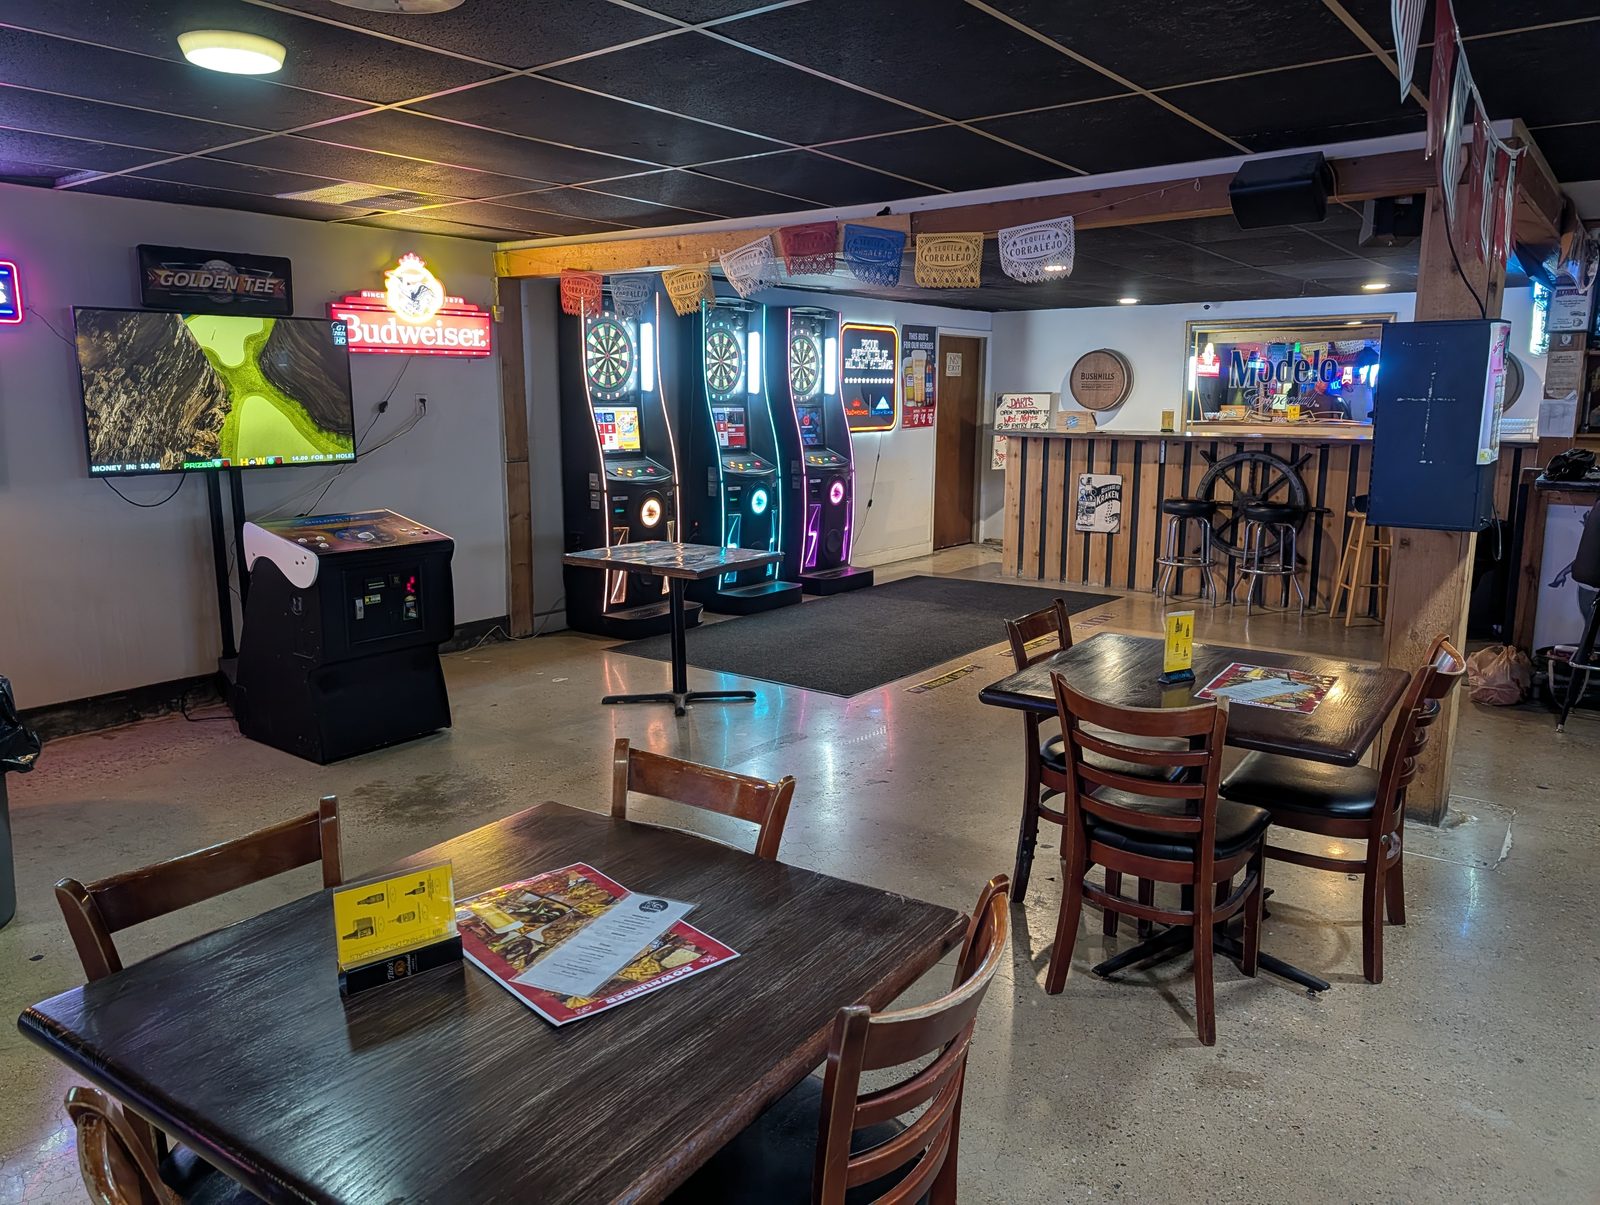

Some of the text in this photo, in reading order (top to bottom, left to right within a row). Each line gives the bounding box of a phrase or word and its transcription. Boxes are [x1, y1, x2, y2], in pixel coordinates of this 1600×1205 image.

[1020, 235, 1051, 246] TEQUILA
[934, 245, 962, 253] TEQUILA
[1010, 240, 1063, 257] CORRALEJO
[924, 253, 971, 262] CORRALEJO
[160, 271, 274, 293] GOLDEN TEE
[672, 279, 704, 293] CORRALEJO
[362, 291, 385, 299] SINCE
[909, 332, 918, 341] THIS
[911, 341, 919, 349] OUR
[919, 342, 934, 350] HEROES
[1228, 348, 1339, 390] Modelo
[1080, 372, 1115, 380] BUSHMILLS
[1010, 397, 1034, 408] DARTS
[140, 462, 160, 470] $0.00
[183, 461, 213, 469] PRIZES
[1096, 490, 1120, 506] KRAKEN
[605, 965, 694, 1004] DOWNUNDER
